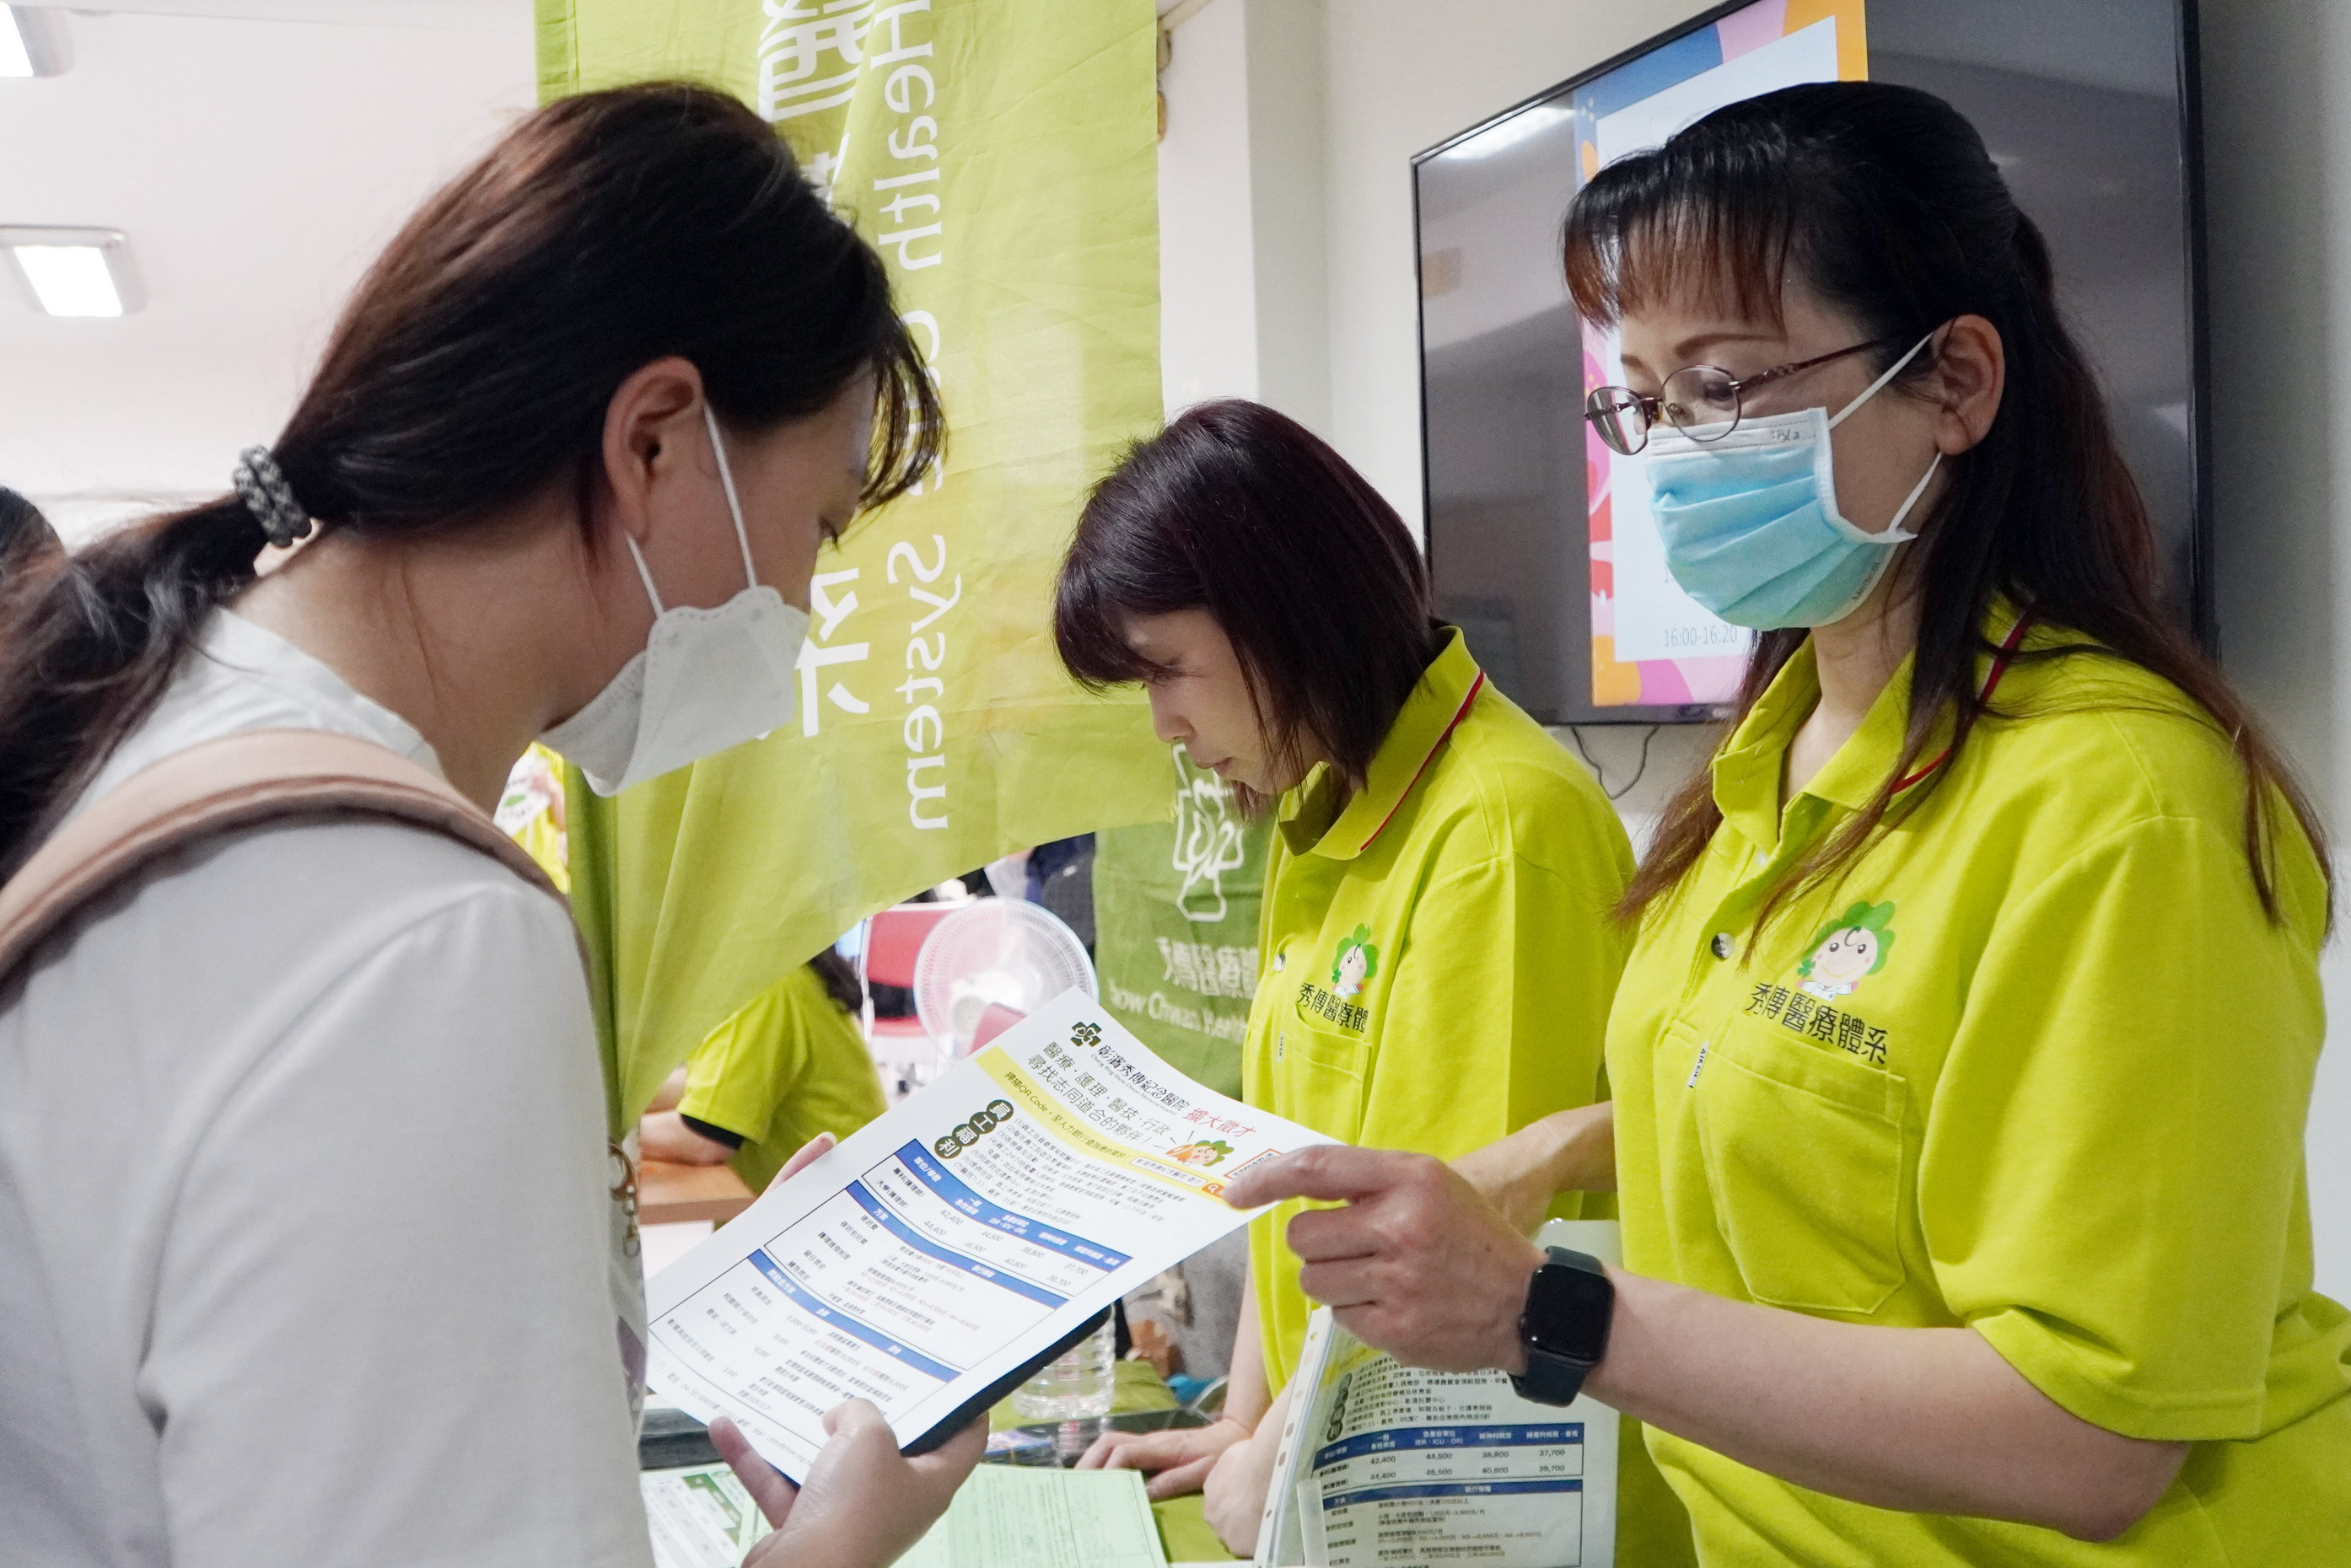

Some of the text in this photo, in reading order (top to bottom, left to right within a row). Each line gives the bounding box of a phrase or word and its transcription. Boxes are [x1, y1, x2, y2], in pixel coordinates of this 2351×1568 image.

[1746, 982, 1888, 1064] 秀傳醫療體系
[1096, 1044, 1257, 1139] 彰濱秀傳紀念醫院 擴大徵才
[938, 1102, 1012, 1157] 員工福利
[1539, 1448, 1566, 1458] 37,700
